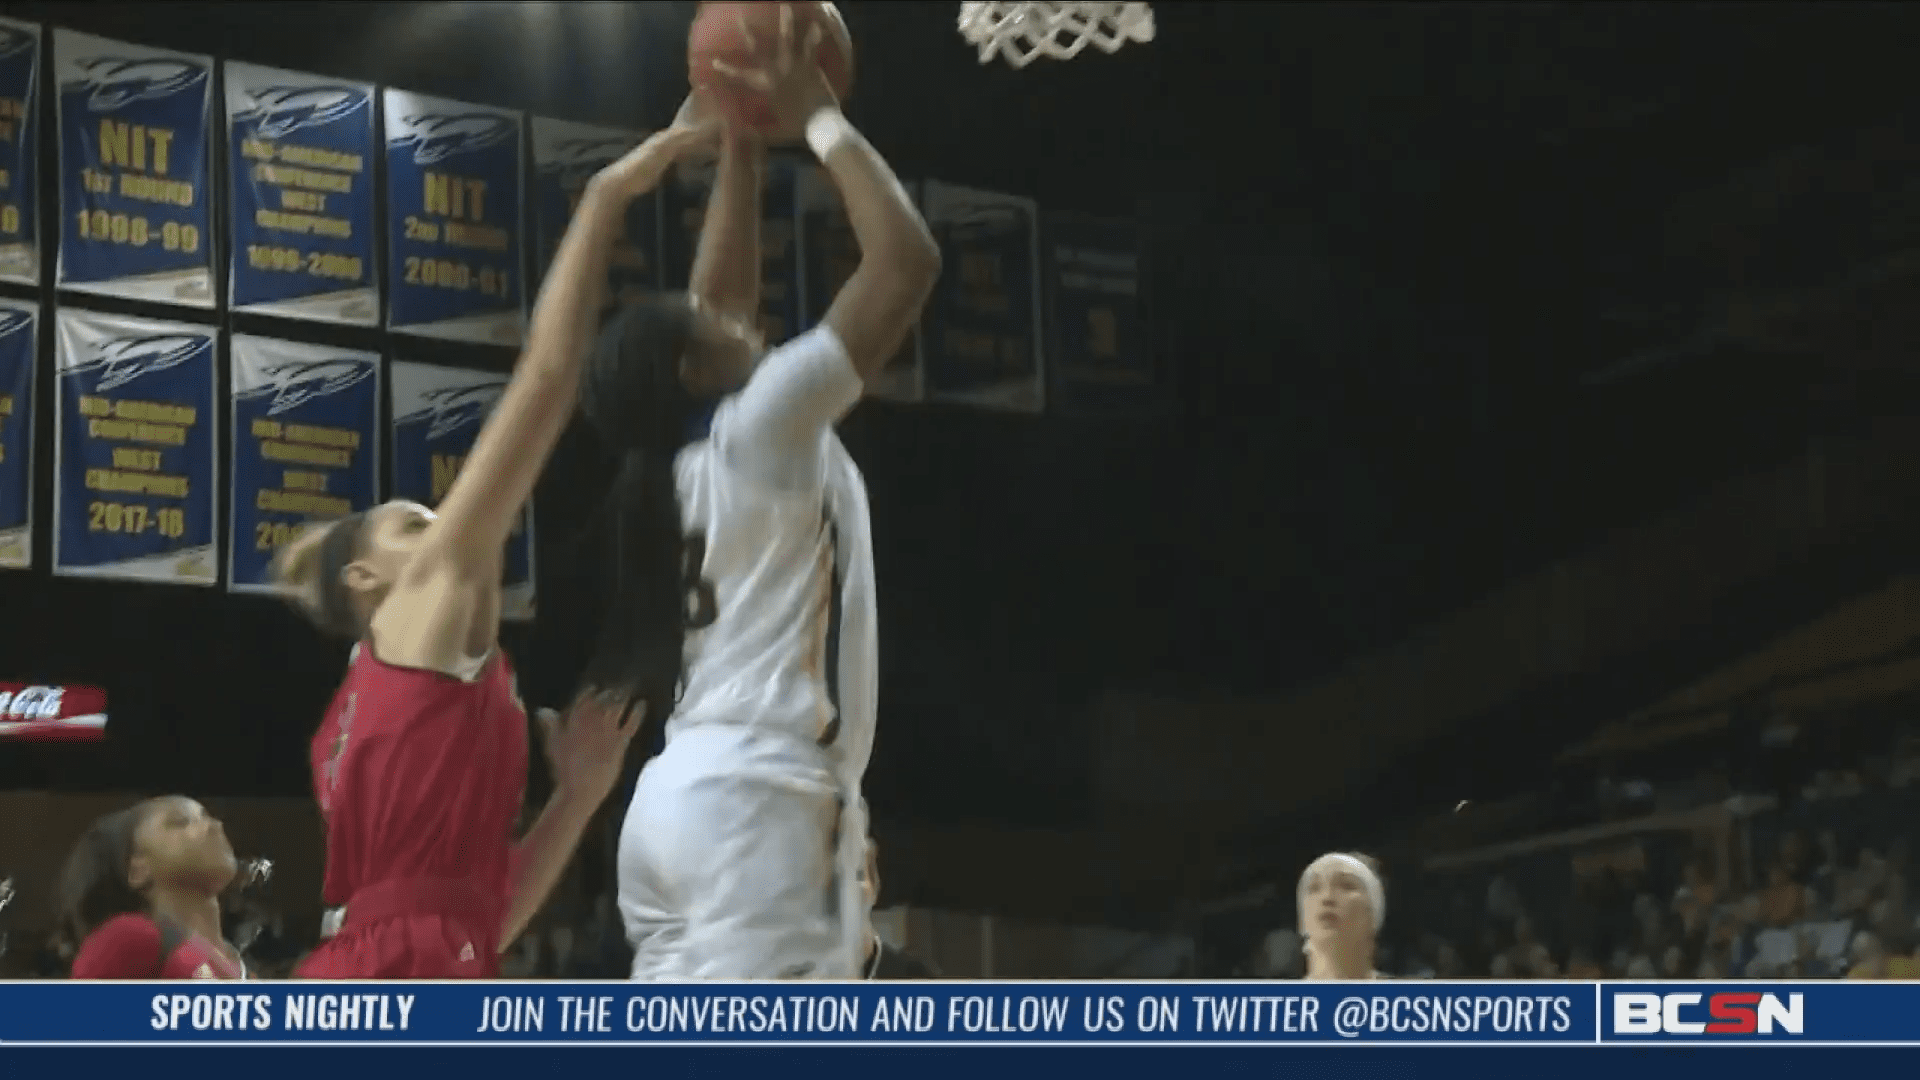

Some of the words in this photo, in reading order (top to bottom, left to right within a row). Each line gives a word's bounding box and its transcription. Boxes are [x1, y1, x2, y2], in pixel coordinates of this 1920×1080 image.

[99, 119, 174, 174] NIT
[424, 172, 488, 222] NIT
[112, 446, 161, 470] WEST
[88, 501, 185, 538] 2017-18
